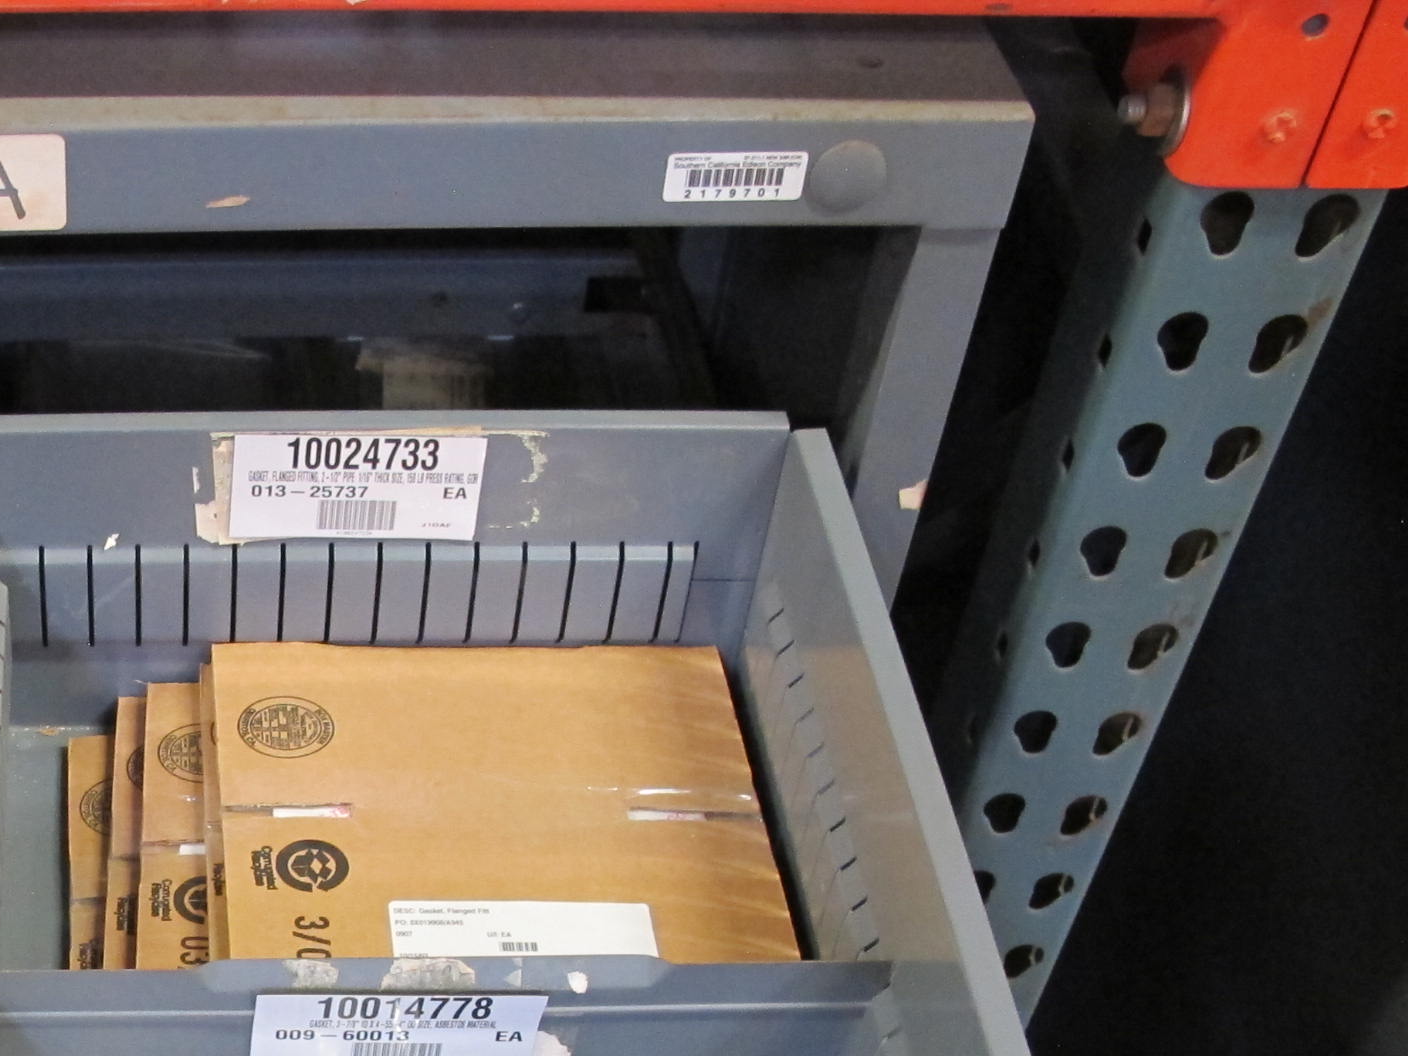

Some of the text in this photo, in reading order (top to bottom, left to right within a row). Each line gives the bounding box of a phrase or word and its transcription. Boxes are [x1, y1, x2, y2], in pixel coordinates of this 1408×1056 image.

[684, 188, 781, 199] 2179701
[287, 436, 440, 471] 10024733
[443, 486, 467, 499] EA
[317, 996, 494, 1020] 10014778
[495, 1030, 523, 1043] EA
